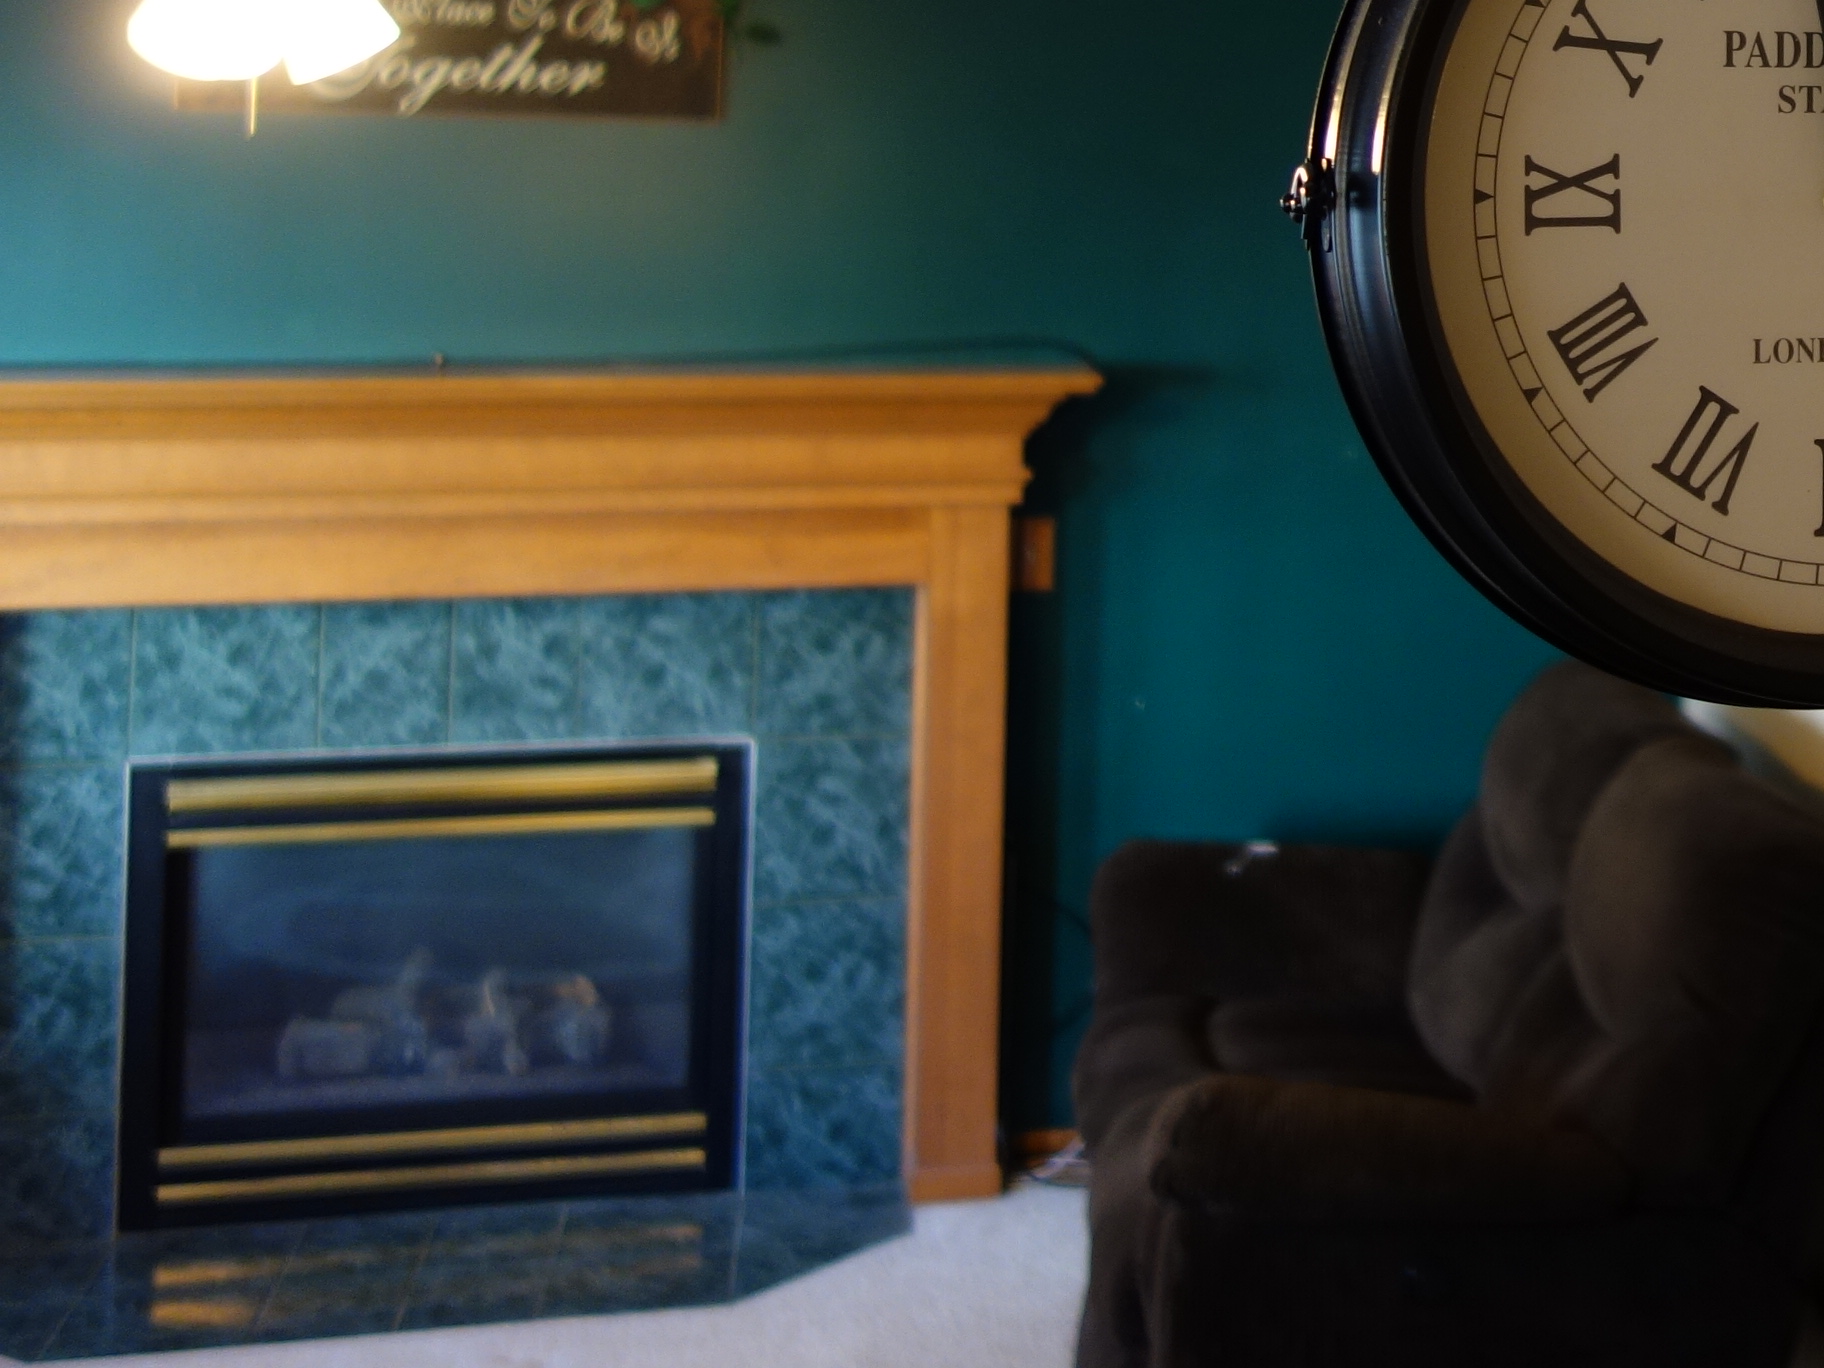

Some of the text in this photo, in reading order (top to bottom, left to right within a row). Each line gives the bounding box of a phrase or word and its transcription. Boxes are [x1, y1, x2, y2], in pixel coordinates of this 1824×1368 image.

[1523, 152, 1622, 237] IX
[1546, 281, 1660, 404] VIII
[1651, 384, 1760, 517] VII
